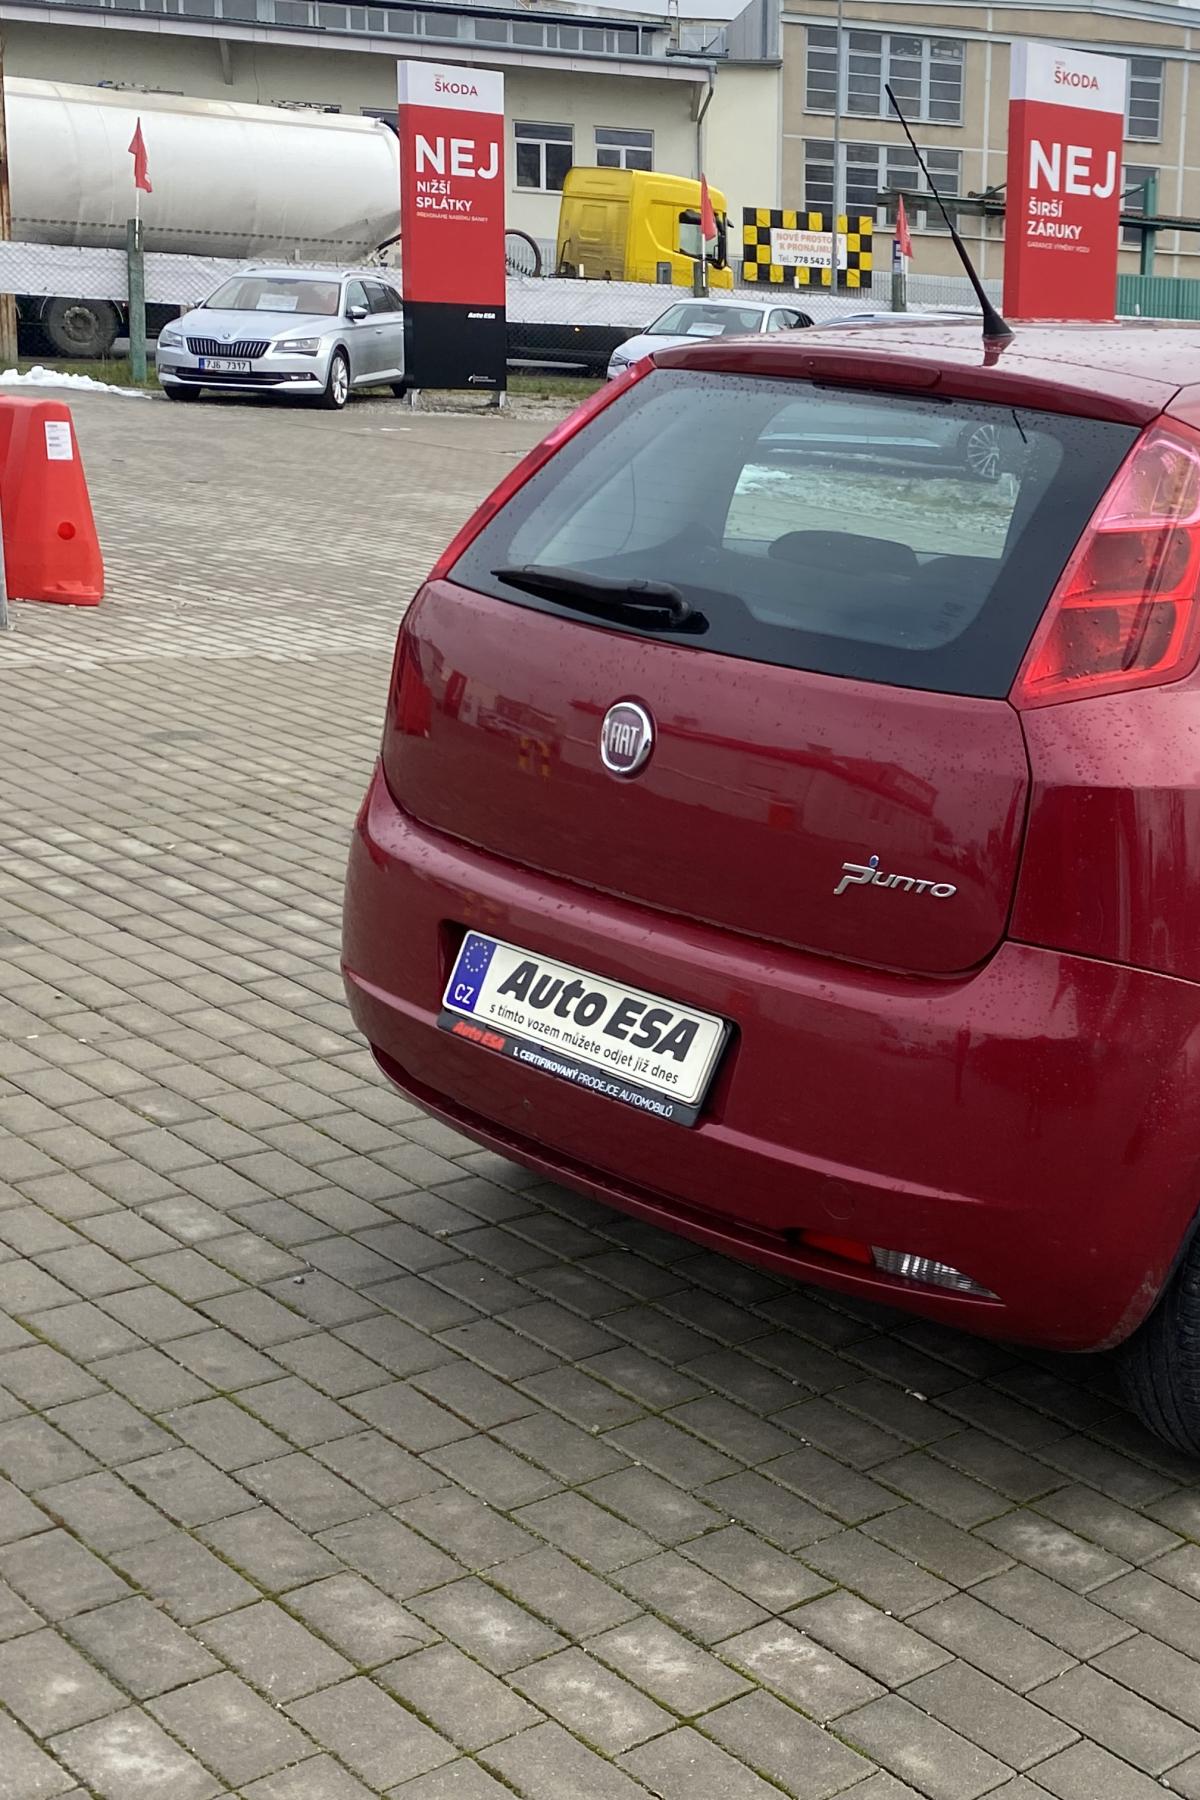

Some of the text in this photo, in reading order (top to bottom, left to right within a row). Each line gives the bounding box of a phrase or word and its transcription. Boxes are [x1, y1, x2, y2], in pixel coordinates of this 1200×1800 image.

[434, 78, 478, 96] ŠKODA
[1054, 66, 1099, 89] ŠKODA
[415, 134, 499, 180] NEJ
[1028, 139, 1116, 198] NEJ
[416, 179, 451, 195] NIŽŠÍ
[416, 196, 472, 211] SPLÁTKY
[1028, 197, 1063, 218] ŠIRŠÍ
[776, 231, 843, 244] NOVÉ PROSTOY
[1027, 219, 1082, 240] ZÁRUKY
[794, 255, 809, 264] 778
[810, 257, 825, 265] 542
[608, 722, 640, 758] FIAT
[833, 855, 957, 898] Punto
[454, 983, 475, 1005] CZ
[497, 960, 700, 1062] Auto ESA
[489, 1003, 496, 1013] s
[527, 1017, 560, 1040] vozem
[561, 1031, 602, 1054] můžete
[603, 1046, 634, 1068] odjet
[633, 1057, 650, 1073] již
[651, 1065, 679, 1085] dnes
[519, 1049, 579, 1080] CERTIFIKOVANÝ
[578, 1073, 621, 1097] PRODEJCE
[619, 1089, 674, 1118] AUTOMOBILŮ
